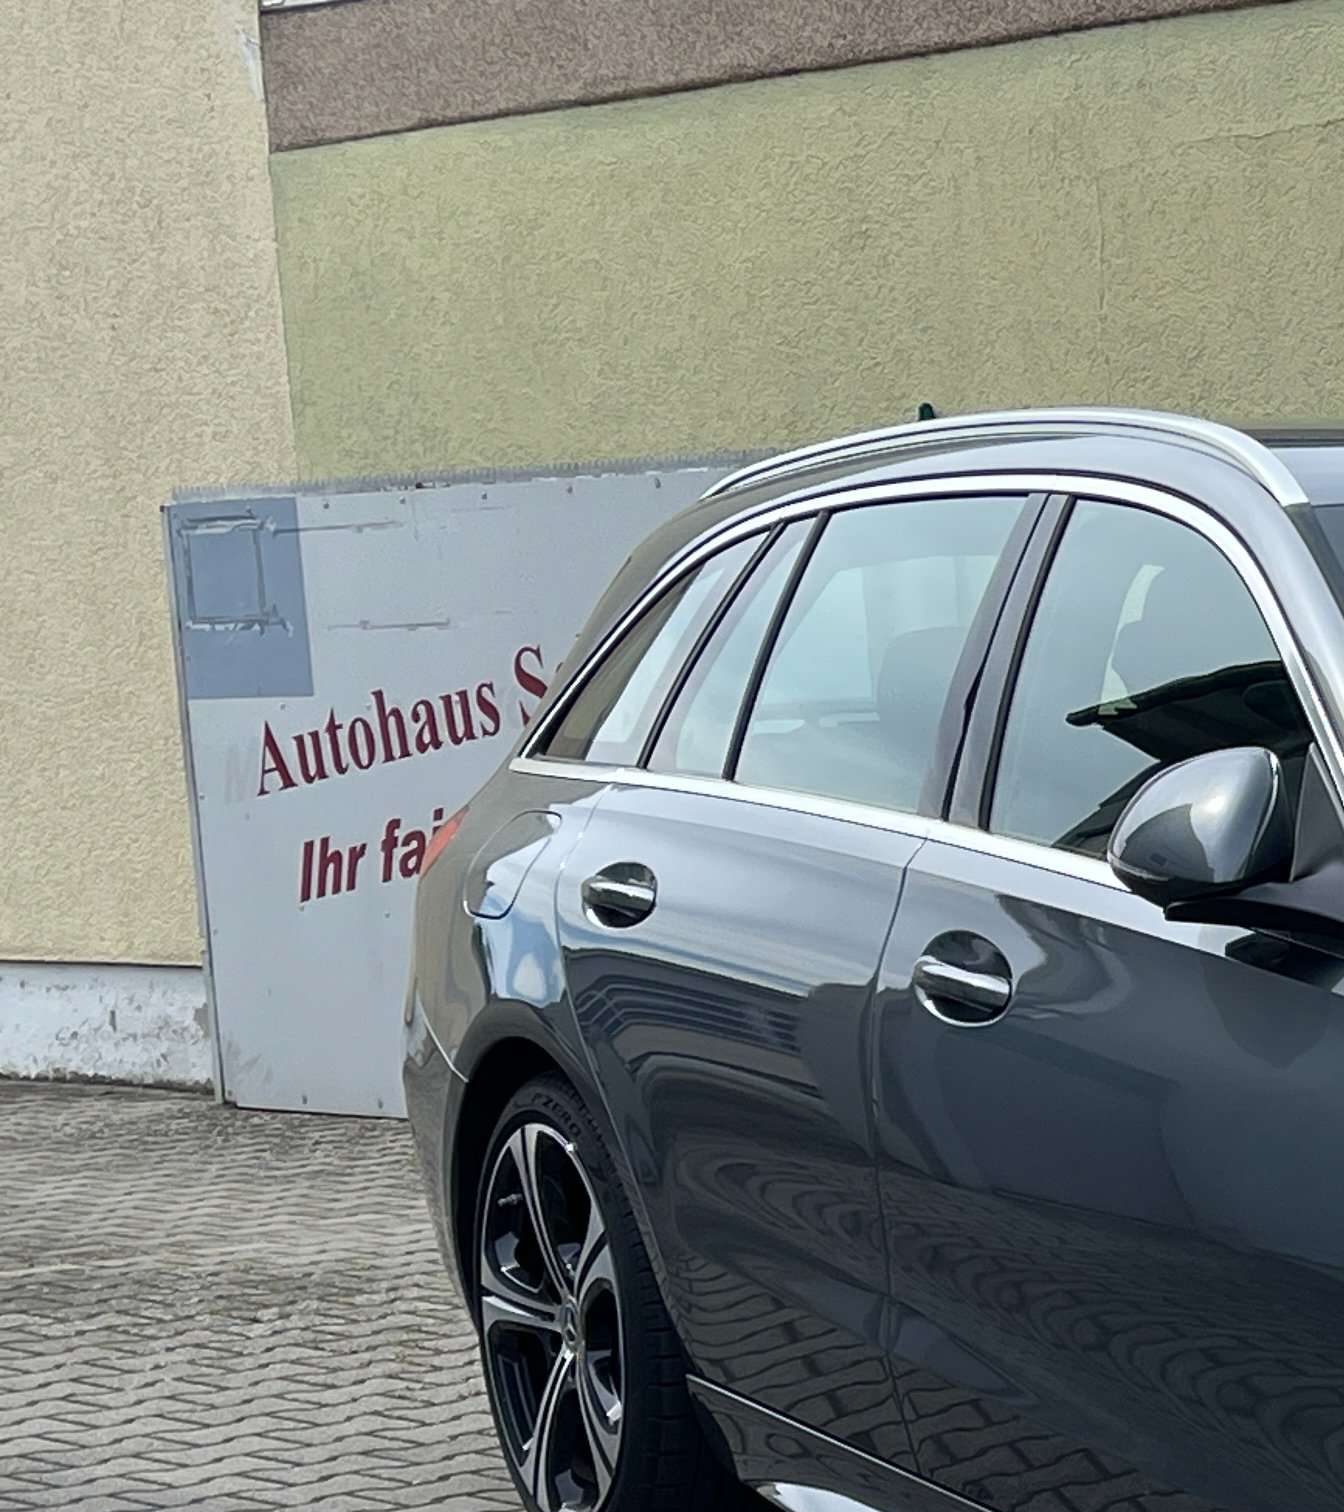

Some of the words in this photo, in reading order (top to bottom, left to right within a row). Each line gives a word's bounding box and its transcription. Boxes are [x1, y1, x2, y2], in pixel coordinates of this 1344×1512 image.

[257, 681, 501, 797] Autohaus
[513, 644, 563, 728] S
[300, 836, 368, 904] Ihr
